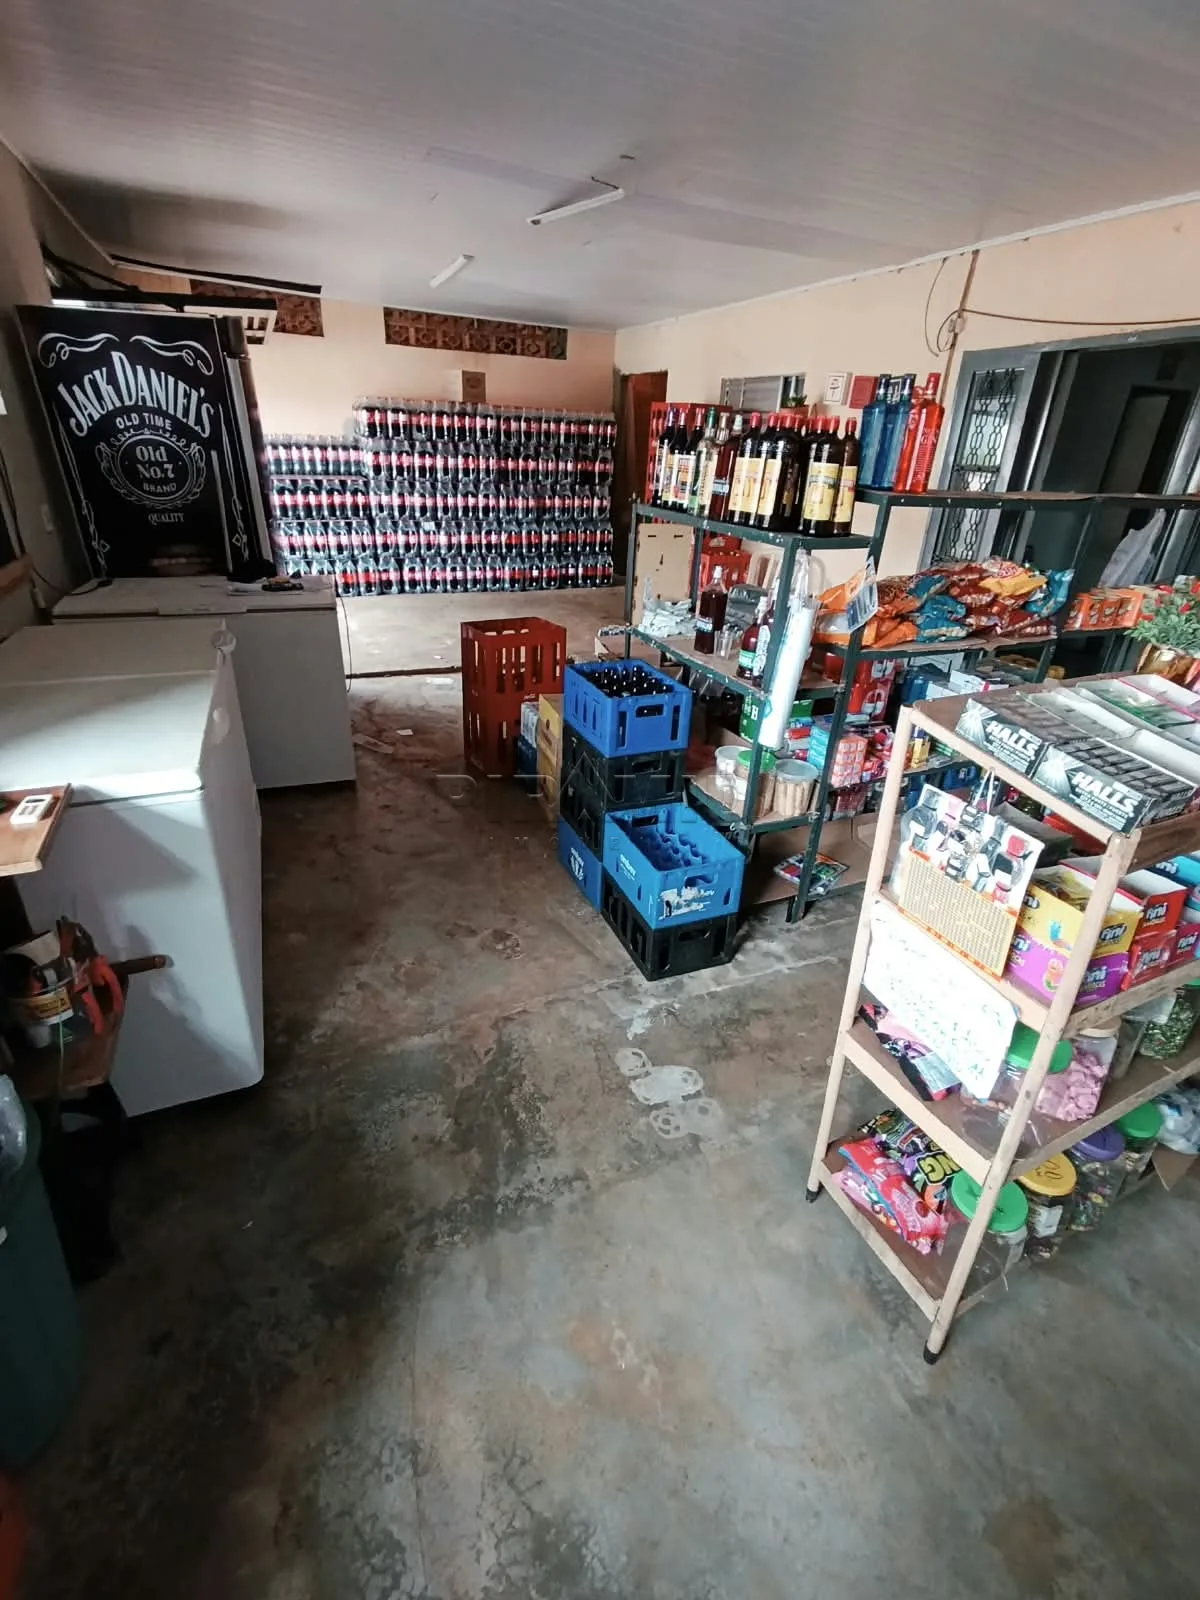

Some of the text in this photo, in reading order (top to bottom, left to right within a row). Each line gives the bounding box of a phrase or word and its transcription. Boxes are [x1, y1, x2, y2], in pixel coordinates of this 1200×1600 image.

[57, 351, 214, 438] JACK DANIEL'S
[115, 412, 172, 429] OLD TIME
[135, 445, 168, 462] Old
[143, 482, 177, 493] BRAND
[148, 512, 185, 526] QUALITY
[985, 720, 1038, 758] HALLS
[1072, 771, 1138, 814] HALLS
